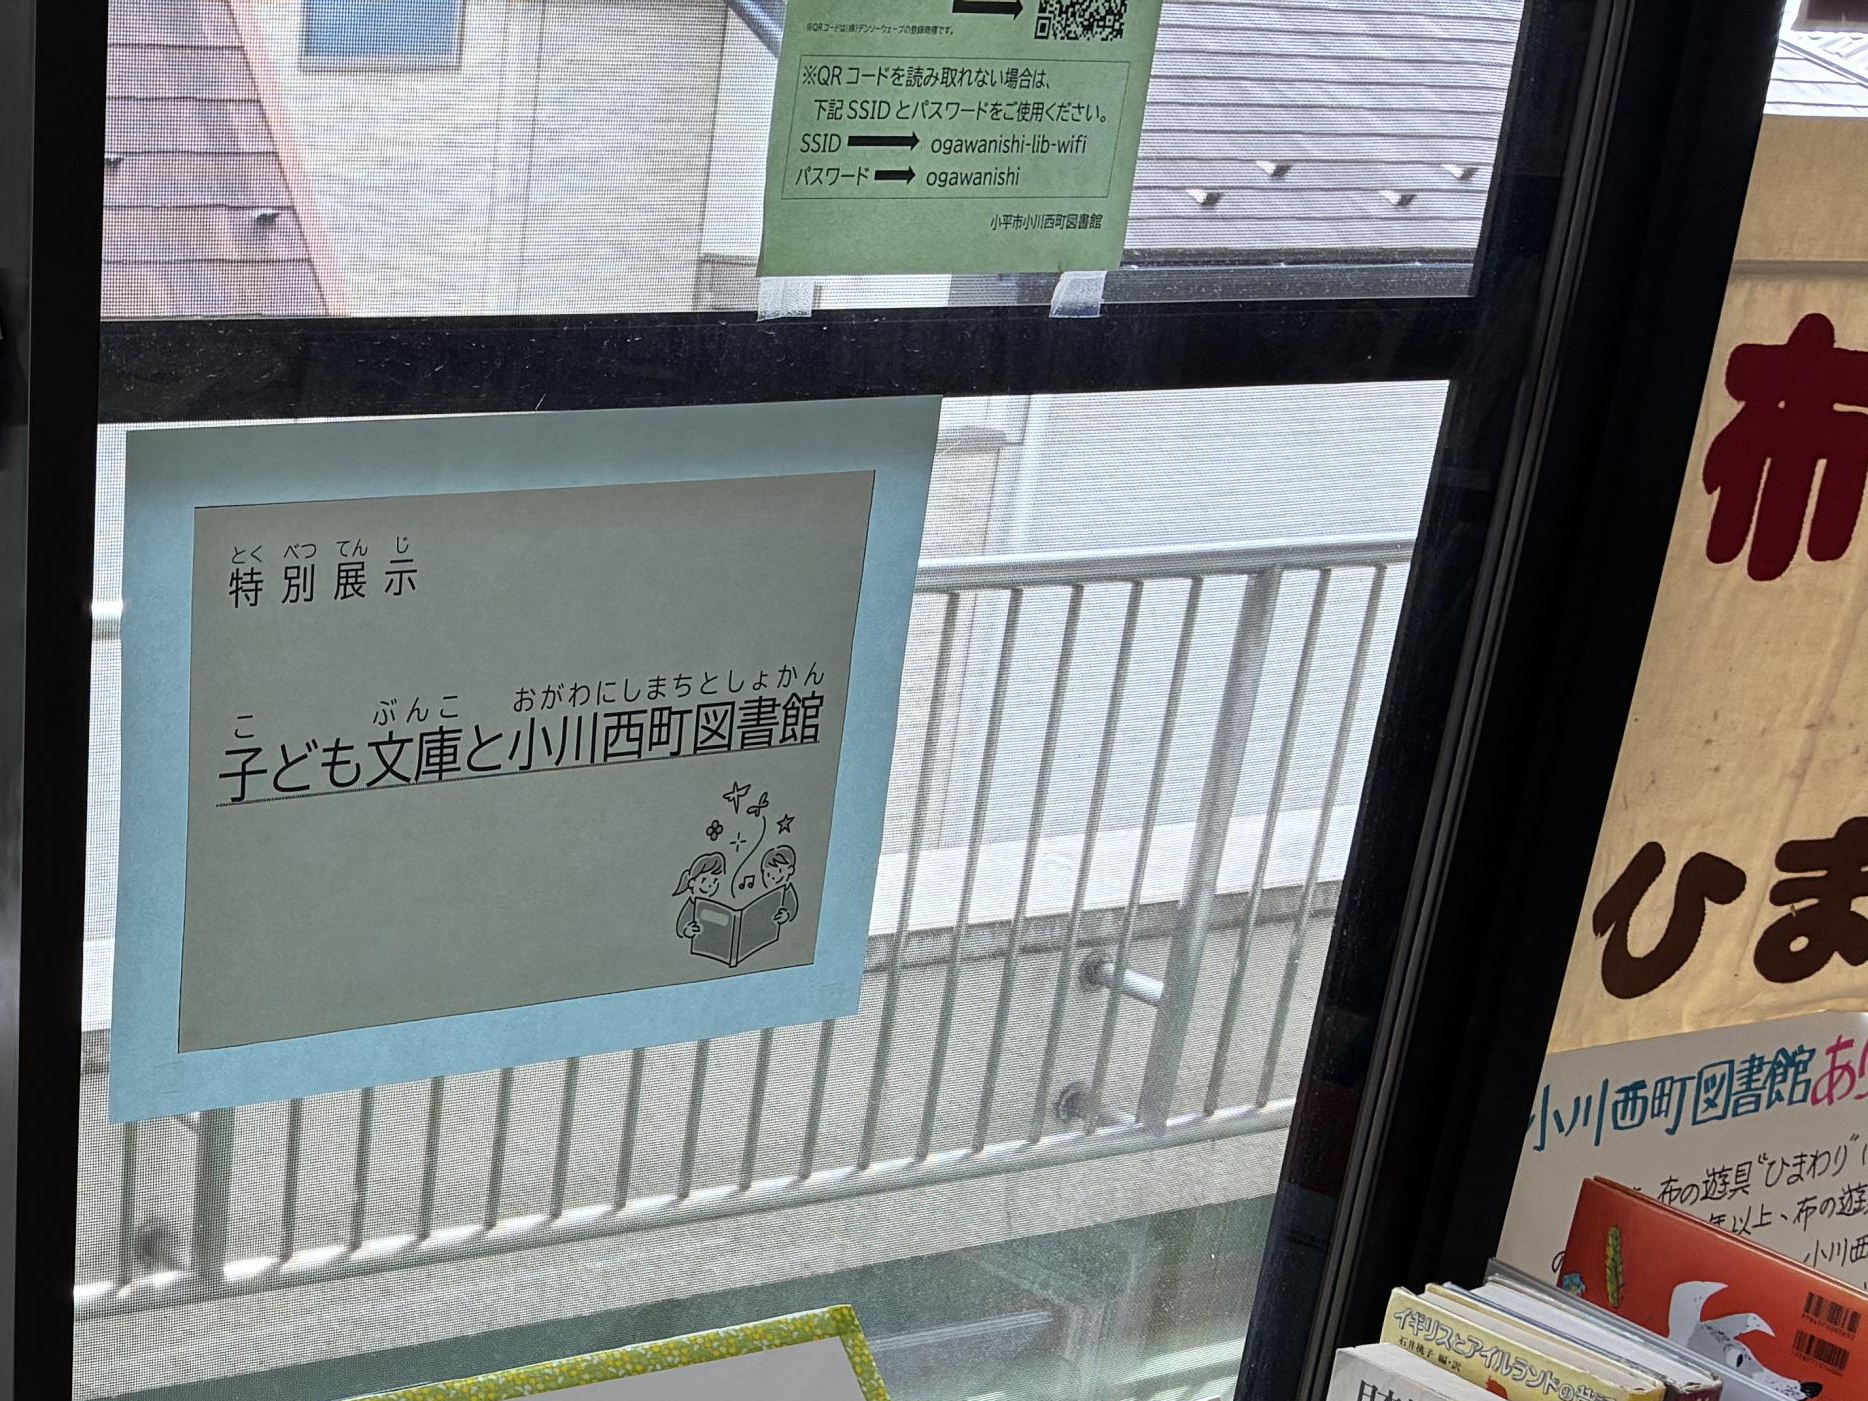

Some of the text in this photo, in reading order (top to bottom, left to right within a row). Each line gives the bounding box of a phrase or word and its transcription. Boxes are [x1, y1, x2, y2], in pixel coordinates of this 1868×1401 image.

[813, 99, 1107, 124] 下記SSIDとパスワードをご使用ください。
[800, 133, 1087, 155] SSID ogawanishi-lib-wifi
[796, 166, 1020, 189] パスワード ogawanishi
[990, 214, 1103, 231] 小平市小川西町図書館
[231, 538, 369, 564] とく べつ てん
[228, 556, 419, 608] 特別展示
[373, 661, 826, 725] ぶんこ おがわにしまちとしょかん
[217, 690, 823, 805] 子ども文庫と小川西町図書館
